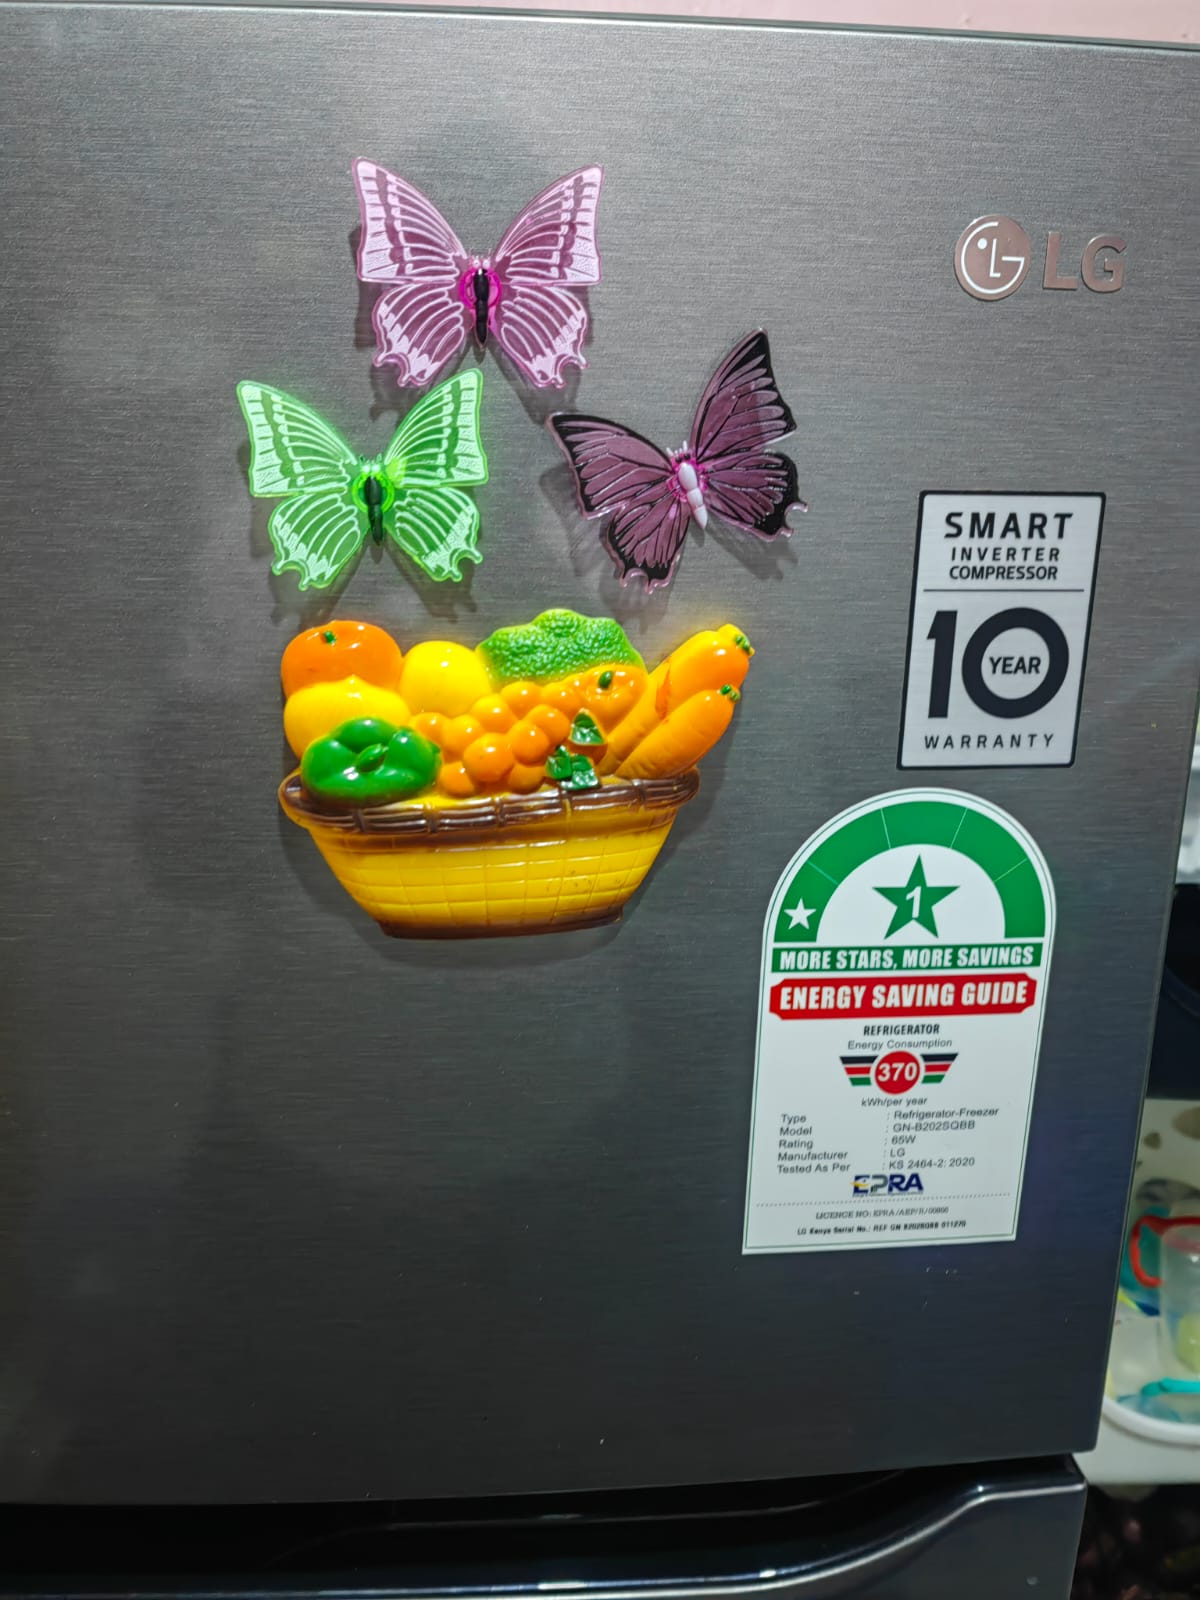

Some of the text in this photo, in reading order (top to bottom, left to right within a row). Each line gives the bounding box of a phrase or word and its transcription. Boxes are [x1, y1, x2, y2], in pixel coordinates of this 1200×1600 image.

[1042, 231, 1127, 293] LG
[944, 512, 1073, 539] SMART
[951, 547, 1060, 562] INVERTER
[950, 565, 1058, 580] COMPRESSOR
[926, 607, 1070, 719] 10 YEAR
[924, 733, 1054, 749] WARRANTY
[905, 886, 922, 919] 1
[779, 946, 1034, 971] MORE STARS, MORE SAVINGS
[779, 980, 1029, 1010] ENERGY SAVING GUIDE
[863, 1023, 940, 1037] REFRIGERATOR
[847, 1038, 953, 1051] Energy Consumption
[877, 1062, 918, 1082] 370
[861, 1097, 928, 1107] kWh/per year
[781, 1113, 807, 1125] Type
[893, 1107, 1000, 1121] Refrigerator-Freezer
[779, 1126, 812, 1136] Model
[779, 1139, 814, 1150] Rating
[777, 1151, 849, 1162] Manufacturer
[889, 1147, 906, 1158] LG
[777, 1163, 851, 1174] Tested As Per
[889, 1160, 904, 1170] KS
[948, 1157, 976, 1168] 2020
[851, 1172, 925, 1194] EPRA
[815, 1211, 854, 1220] LICENCE
[833, 1225, 855, 1234] Serial
